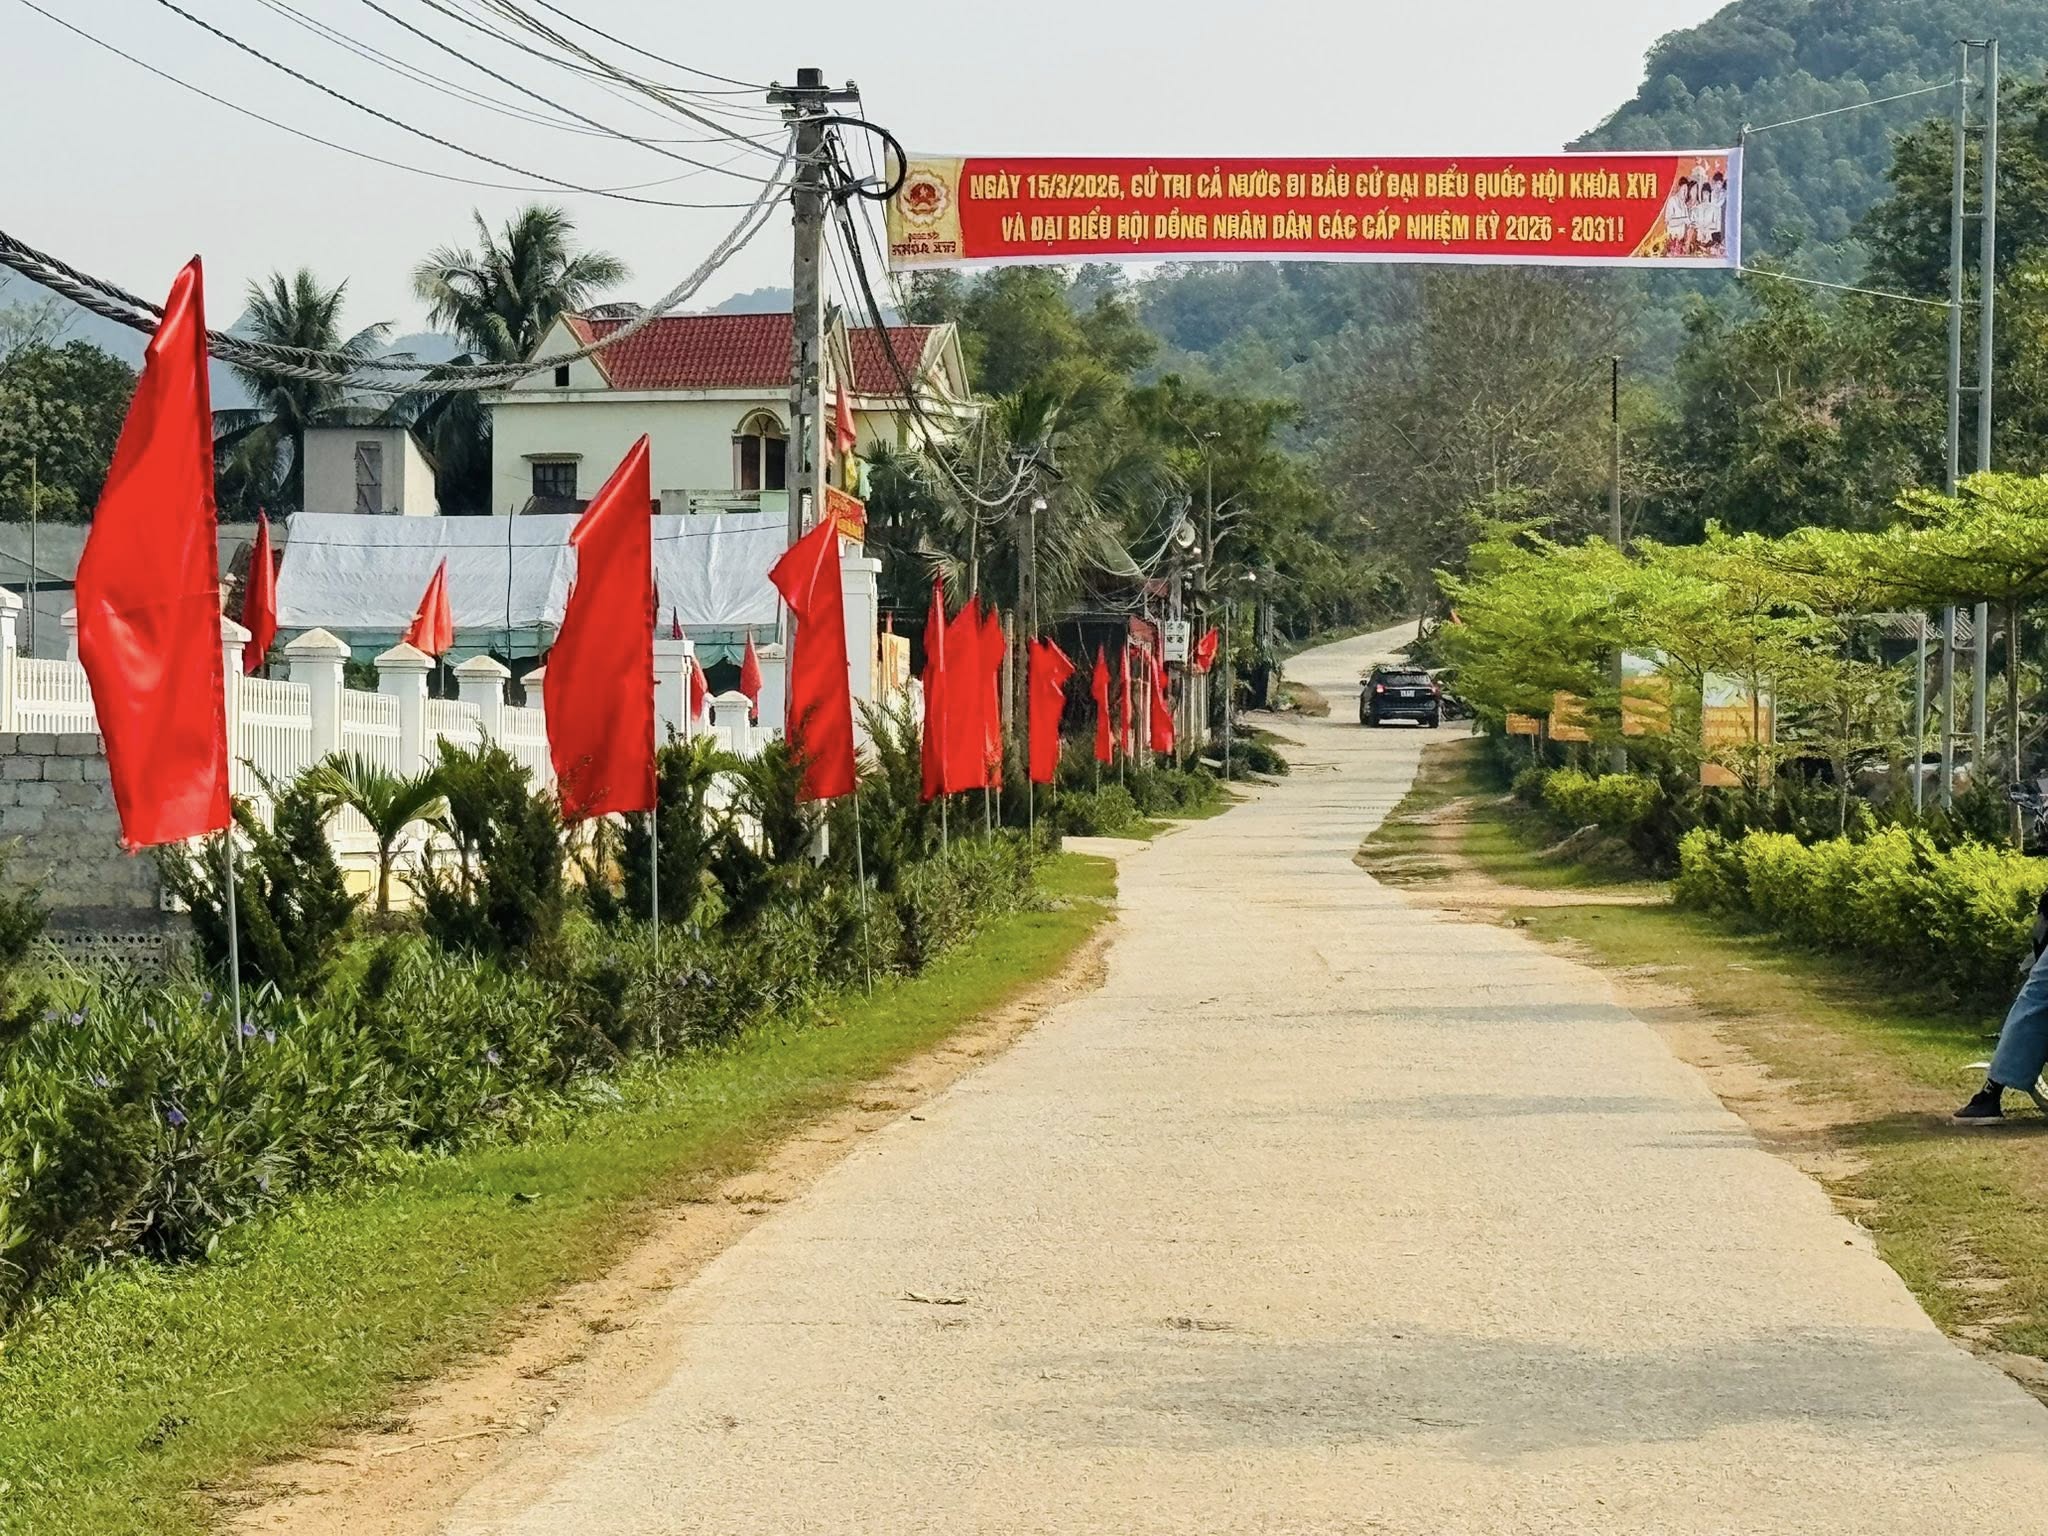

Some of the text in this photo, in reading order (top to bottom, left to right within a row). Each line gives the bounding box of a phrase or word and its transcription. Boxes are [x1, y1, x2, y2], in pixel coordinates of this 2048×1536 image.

[970, 163, 1658, 204] NGÀY 15/3/2026, CỬ TRI CẢ NƯỚC ĐI BẦU CỬ ĐẠI BIỂU QUỐC HỘI KHÓA XVI
[1030, 215, 1063, 247] ĐẠI
[1067, 205, 1112, 241] BIỂU
[1117, 210, 1150, 245] HỘI
[1212, 209, 1267, 240] NHÂN
[1272, 209, 1313, 240] DÂN
[1317, 208, 1358, 240] CÁC
[1361, 205, 1401, 241] CẤP
[1406, 209, 1470, 246] NHIỆM
[1474, 209, 1501, 241] KỲ
[1505, 214, 1553, 242] 2026
[1557, 226, 1566, 234] -
[1570, 215, 1625, 242] 2031!
